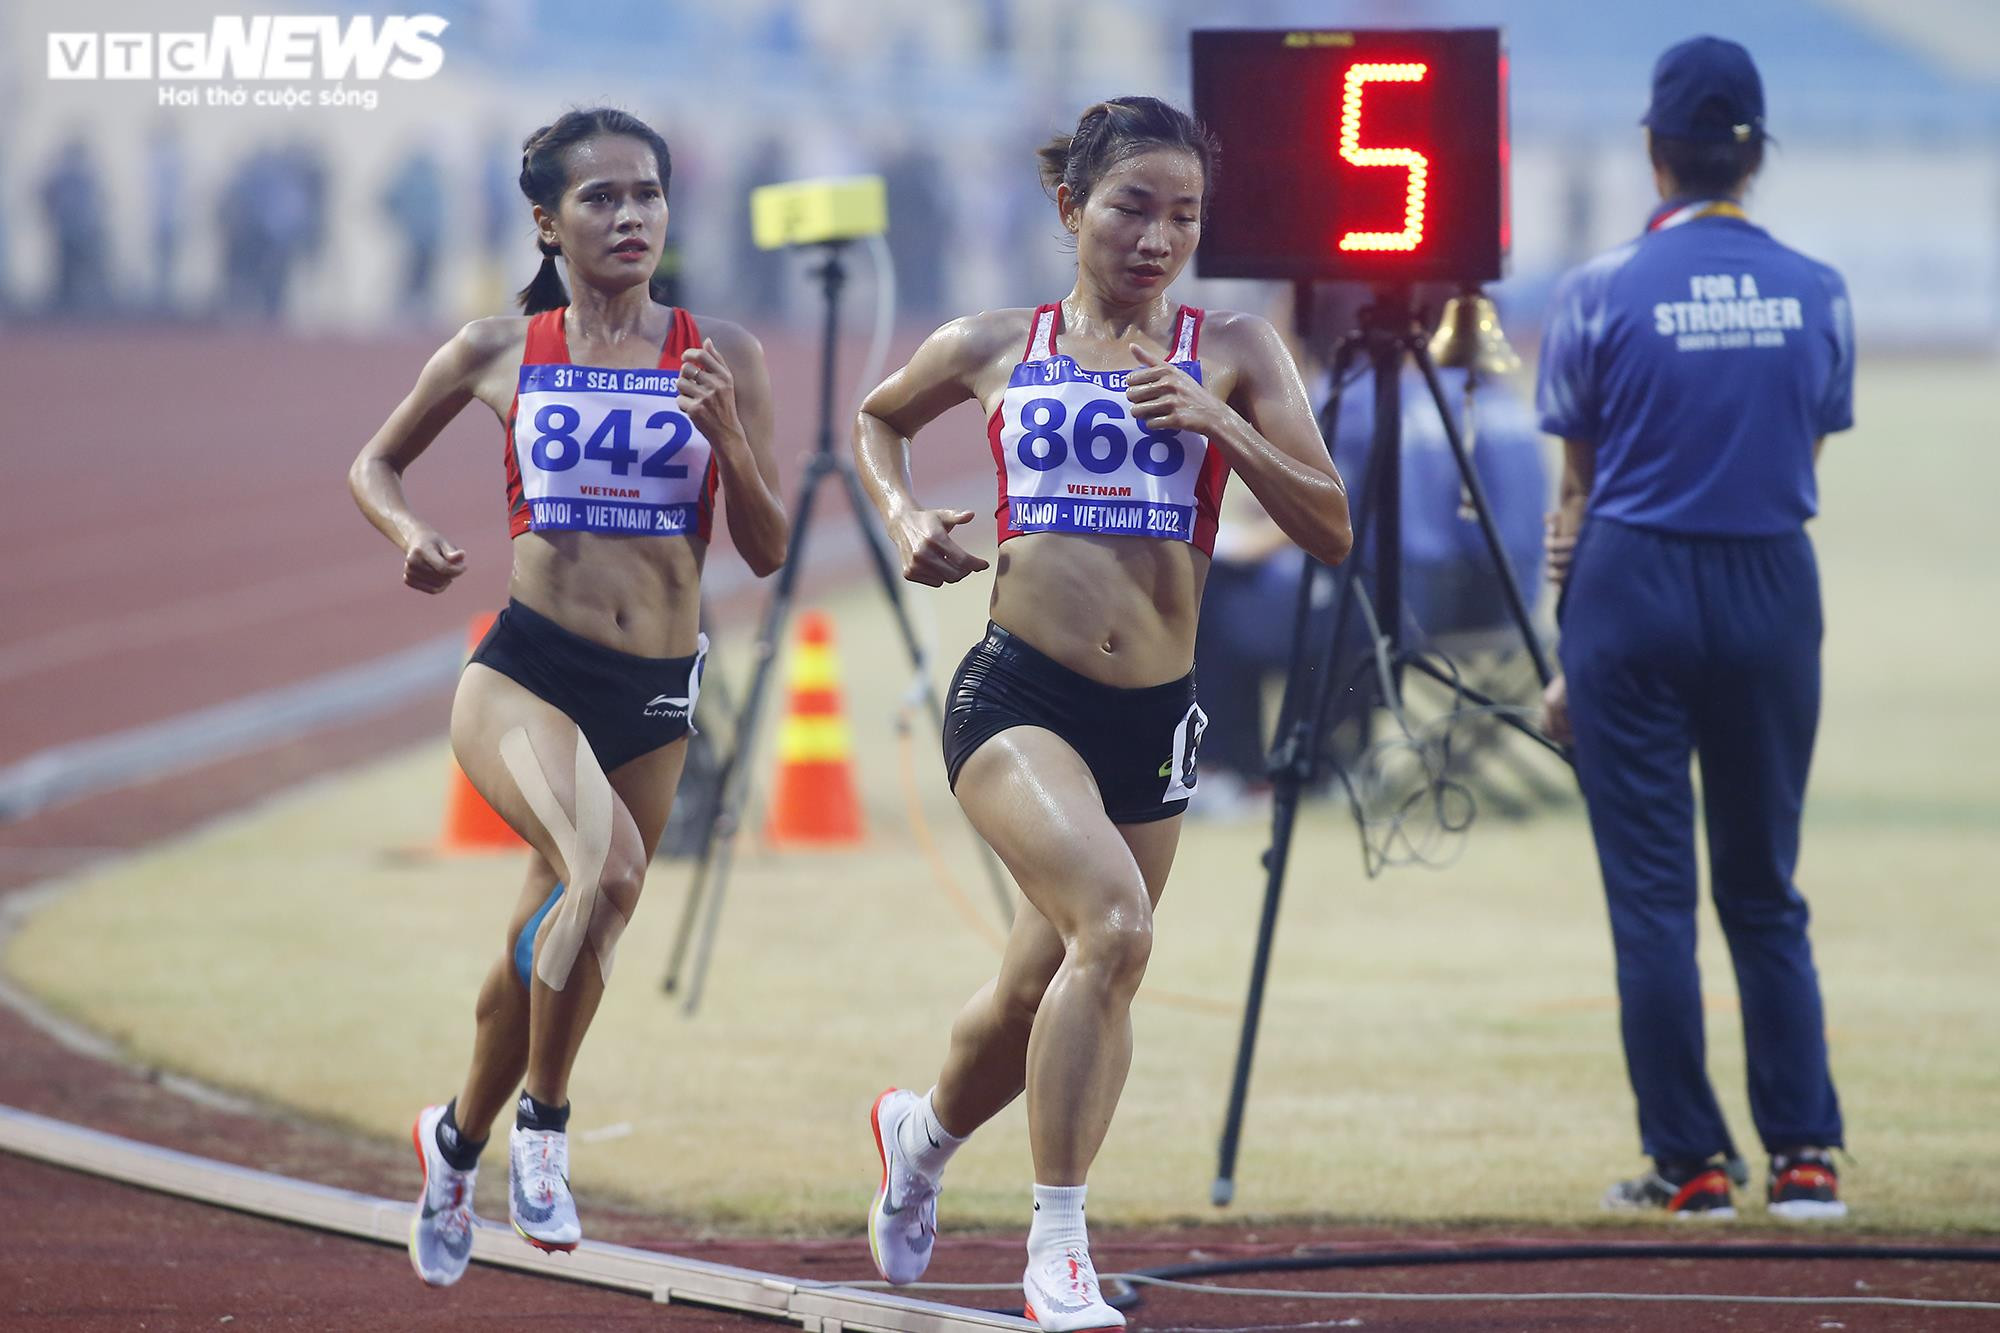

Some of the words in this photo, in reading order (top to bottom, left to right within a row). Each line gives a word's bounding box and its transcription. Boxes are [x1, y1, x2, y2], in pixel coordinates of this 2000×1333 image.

[1339, 62, 1428, 251] 5
[1690, 274, 1737, 299] FOR
[1740, 273, 1760, 299] A
[1654, 298, 1803, 336] STRONGER
[587, 371, 619, 390] SEA
[623, 373, 678, 392] Games
[531, 404, 693, 479] 842
[1017, 398, 1185, 477] 868
[579, 485, 640, 498] VIETNAM
[1066, 483, 1132, 497] VIETNAM
[586, 505, 651, 529] VIETNAM
[655, 509, 686, 530] 2022
[1073, 505, 1143, 529] VIETNAM
[1147, 508, 1179, 533] 2022
[643, 708, 688, 718] LI-NIN
